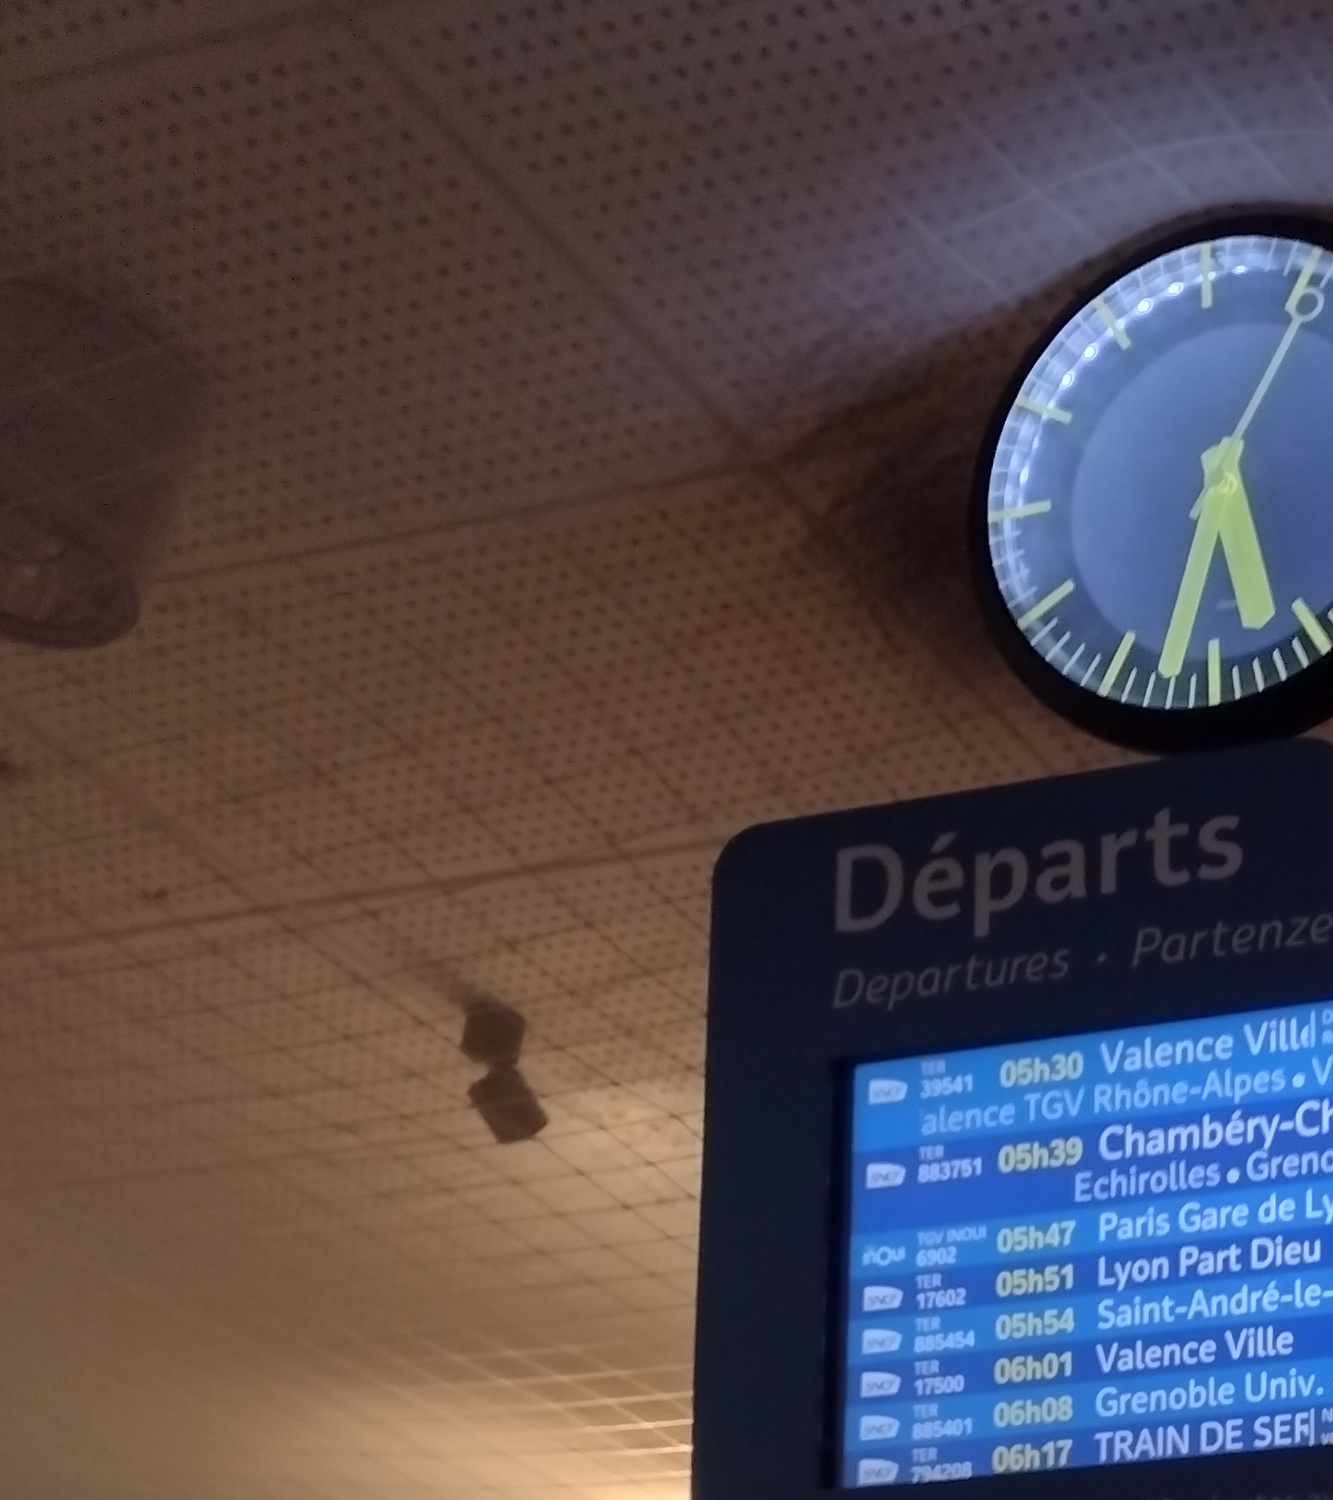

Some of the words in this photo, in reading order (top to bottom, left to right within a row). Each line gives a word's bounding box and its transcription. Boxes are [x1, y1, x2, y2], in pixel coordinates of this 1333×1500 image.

[833, 805, 1244, 936] Départs
[833, 942, 1071, 1011] Departures
[1000, 1051, 1083, 1088] 05h30
[1100, 1031, 1234, 1074] Valence
[921, 1103, 1015, 1136] alence
[1024, 1086, 1085, 1122] TGV
[1093, 1067, 1285, 1114] Rhône-Alpes
[998, 1136, 1083, 1174] 05h39
[1075, 1158, 1221, 1202] Echirolles
[997, 1220, 1076, 1254] 05h47
[1099, 1206, 1170, 1241] Paris
[1178, 1200, 1249, 1234] Gare
[1258, 1192, 1296, 1223] de
[995, 1264, 1074, 1297] 05h51
[1098, 1255, 1169, 1292] Lyon
[1178, 1242, 1242, 1277] Part
[1250, 1235, 1321, 1270] Dieu
[995, 1308, 1074, 1340] 05h54
[994, 1352, 1072, 1385] 06h01
[1097, 1339, 1217, 1373] Valence
[1224, 1326, 1294, 1360] Ville
[993, 1396, 1073, 1428] 06h08
[1095, 1376, 1235, 1417] Grenoble
[1244, 1368, 1324, 1402] Univ.
[992, 1440, 1073, 1475] 06h17
[1094, 1424, 1189, 1463] TRAIN
[1200, 1418, 1243, 1454] DE
